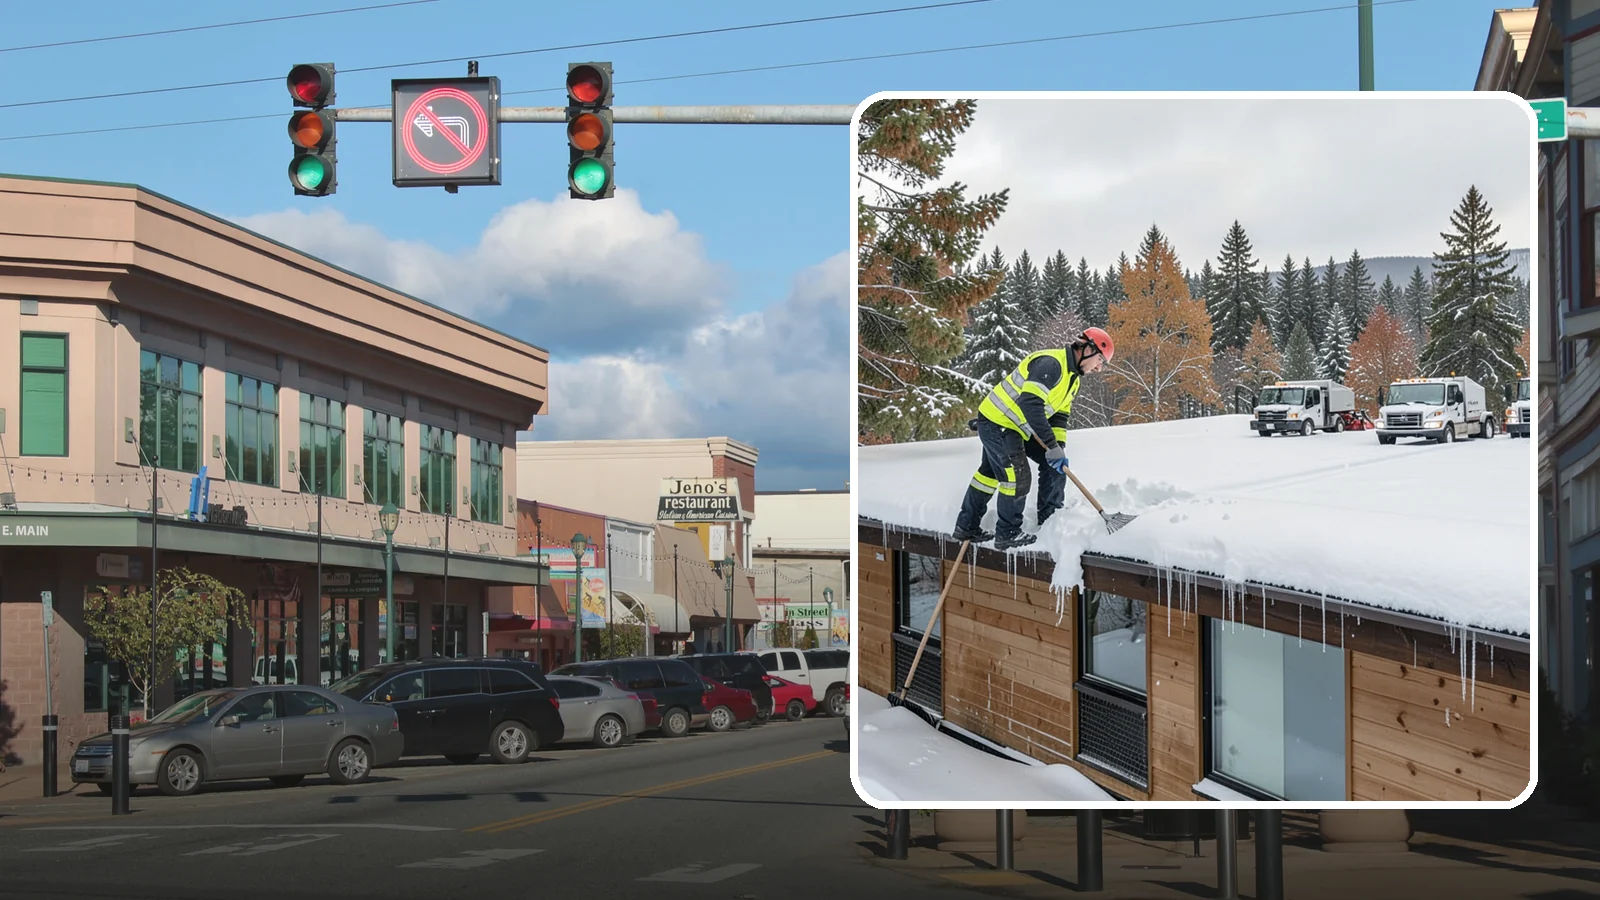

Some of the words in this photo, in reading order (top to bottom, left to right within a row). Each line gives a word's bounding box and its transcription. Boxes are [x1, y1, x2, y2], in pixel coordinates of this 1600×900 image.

[670, 480, 727, 494] Jeno's
[665, 496, 731, 509] restaurant
[658, 510, 681, 519] Italian
[686, 510, 715, 519] American
[715, 509, 737, 519] Cuisine
[2, 525, 13, 536] E.
[15, 525, 49, 536] MAIN
[797, 607, 829, 617] Street
